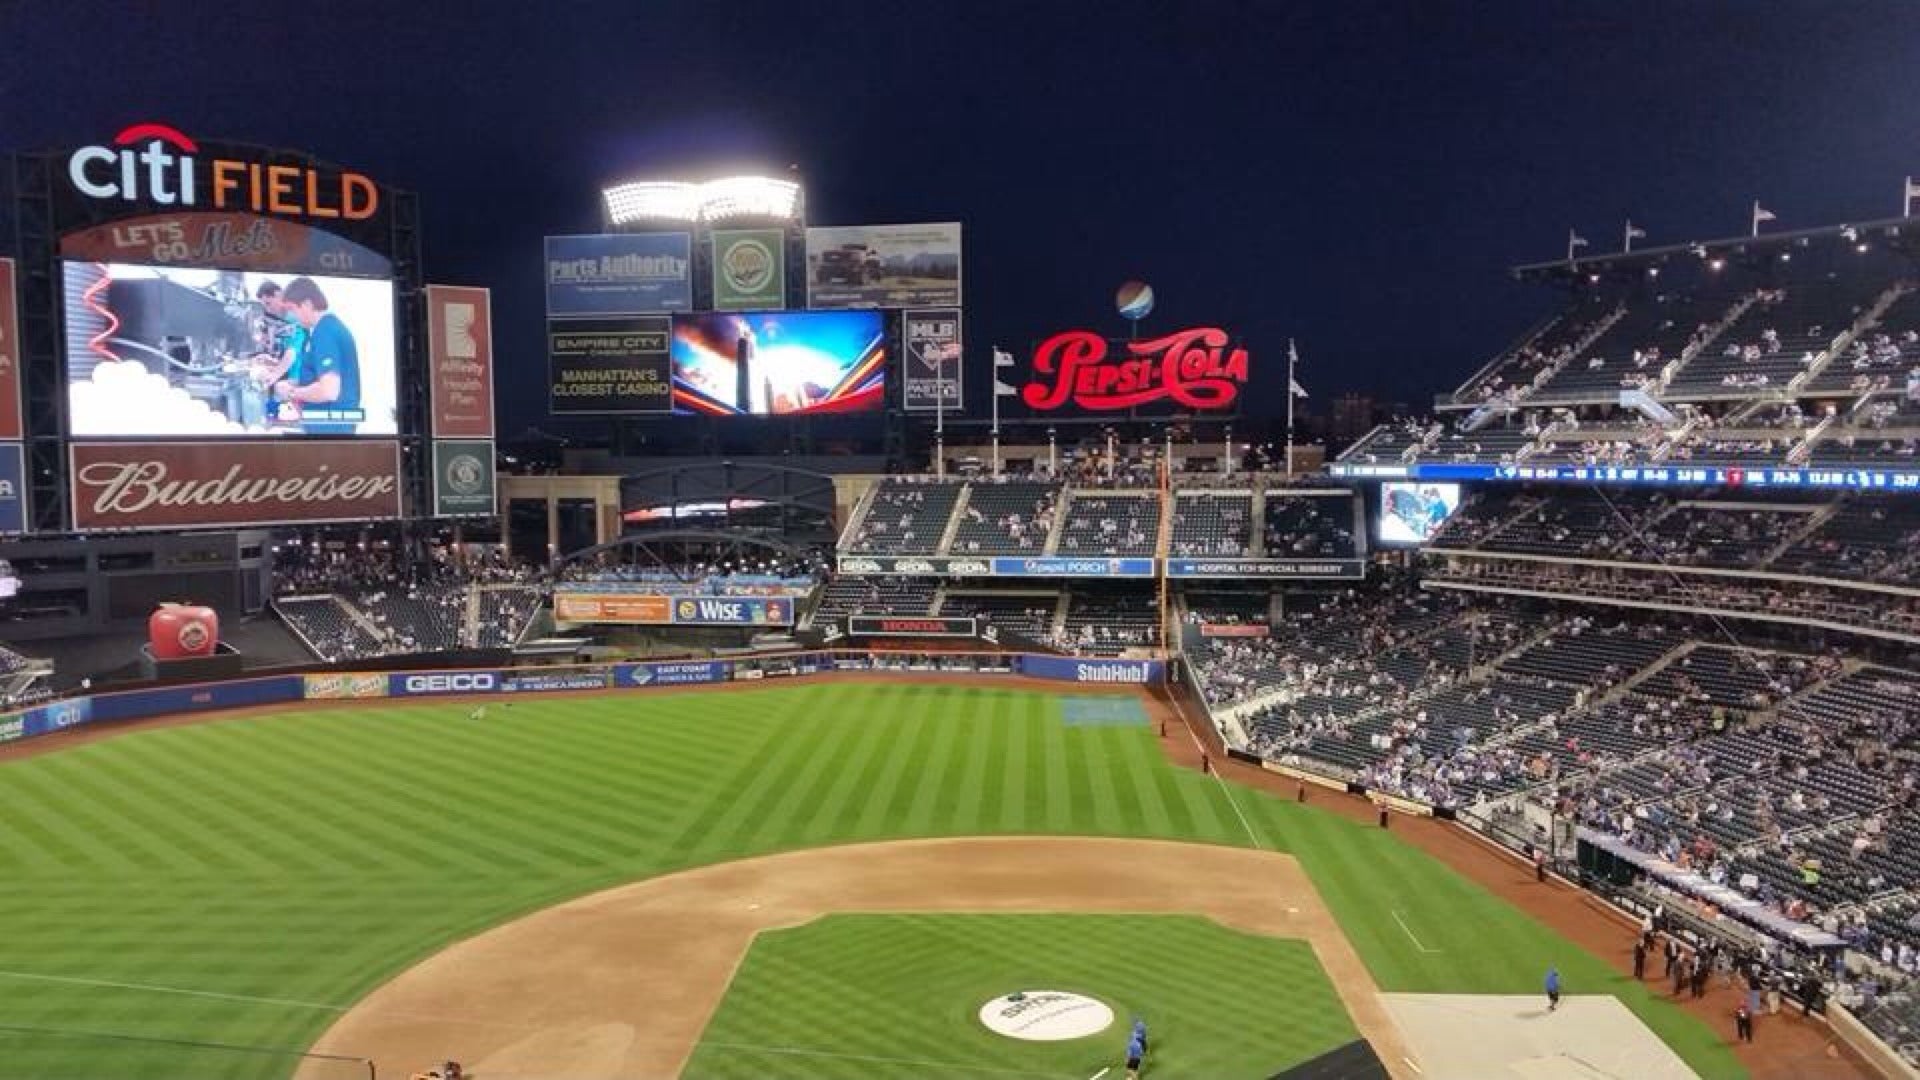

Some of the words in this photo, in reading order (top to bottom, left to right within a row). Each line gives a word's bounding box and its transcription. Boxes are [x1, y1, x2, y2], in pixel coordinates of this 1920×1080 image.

[69, 139, 195, 205] citi
[213, 159, 379, 220] FIELD
[112, 221, 184, 248] LET'S
[153, 241, 189, 263] GO
[601, 254, 687, 280] Authority
[557, 338, 620, 349] EMPIRE
[623, 337, 661, 348] CITY
[561, 368, 658, 382] MANHATTAN'S
[553, 383, 615, 397] CLOSEST
[617, 382, 669, 395] CASINO
[79, 461, 395, 514] Budweiser
[1068, 561, 1105, 573] PORCH
[1198, 564, 1237, 573] HOSPITAL
[1258, 564, 1298, 573] SPECIAL
[882, 620, 948, 632] HONDA
[1078, 661, 1149, 682] StubHub!
[405, 673, 494, 692] GEICO
